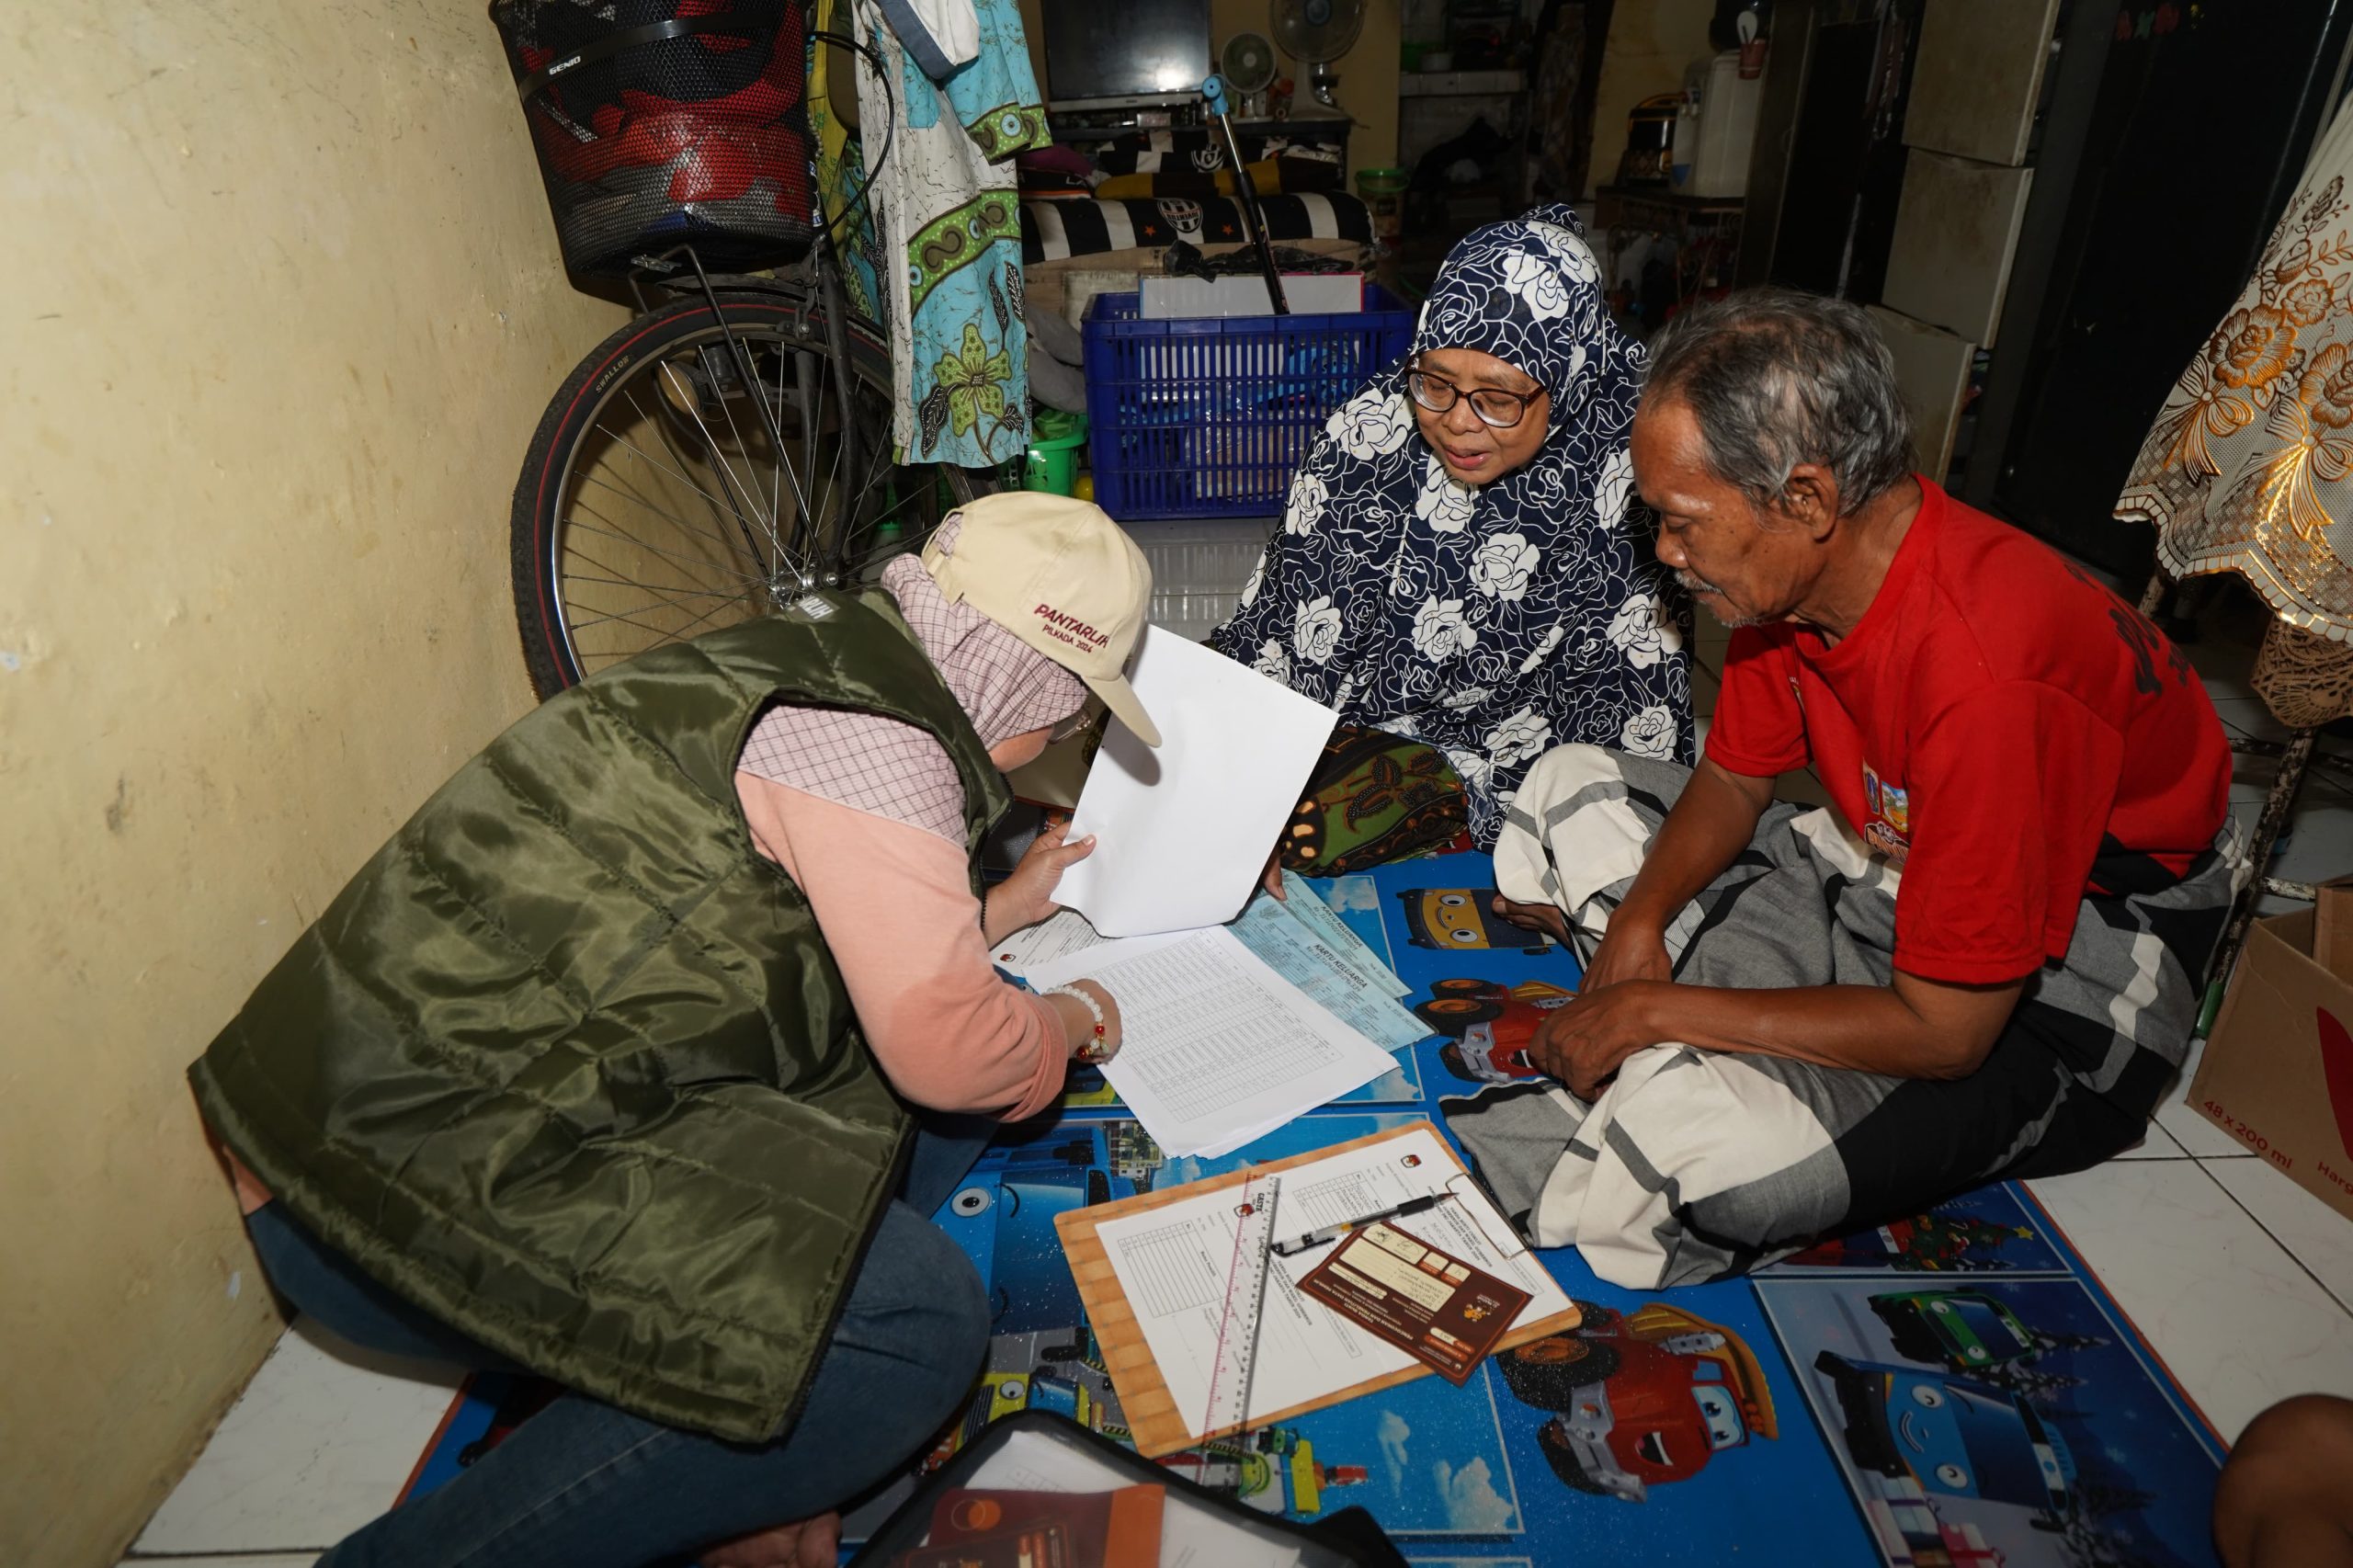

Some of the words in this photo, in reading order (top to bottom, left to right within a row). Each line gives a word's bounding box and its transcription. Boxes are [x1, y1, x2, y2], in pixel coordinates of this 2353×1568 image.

[549, 55, 581, 75] GENIO
[596, 355, 630, 392] SWALLOW
[1042, 624, 1074, 644] PILKADA
[1076, 641, 1093, 653] 2024
[1313, 942, 1336, 962] KARTU
[1333, 958, 1368, 989] KELUARGA
[2204, 1100, 2223, 1118] 48
[2224, 1115, 2234, 1127] x
[2235, 1123, 2268, 1151] 200
[2270, 1150, 2293, 1169] ml
